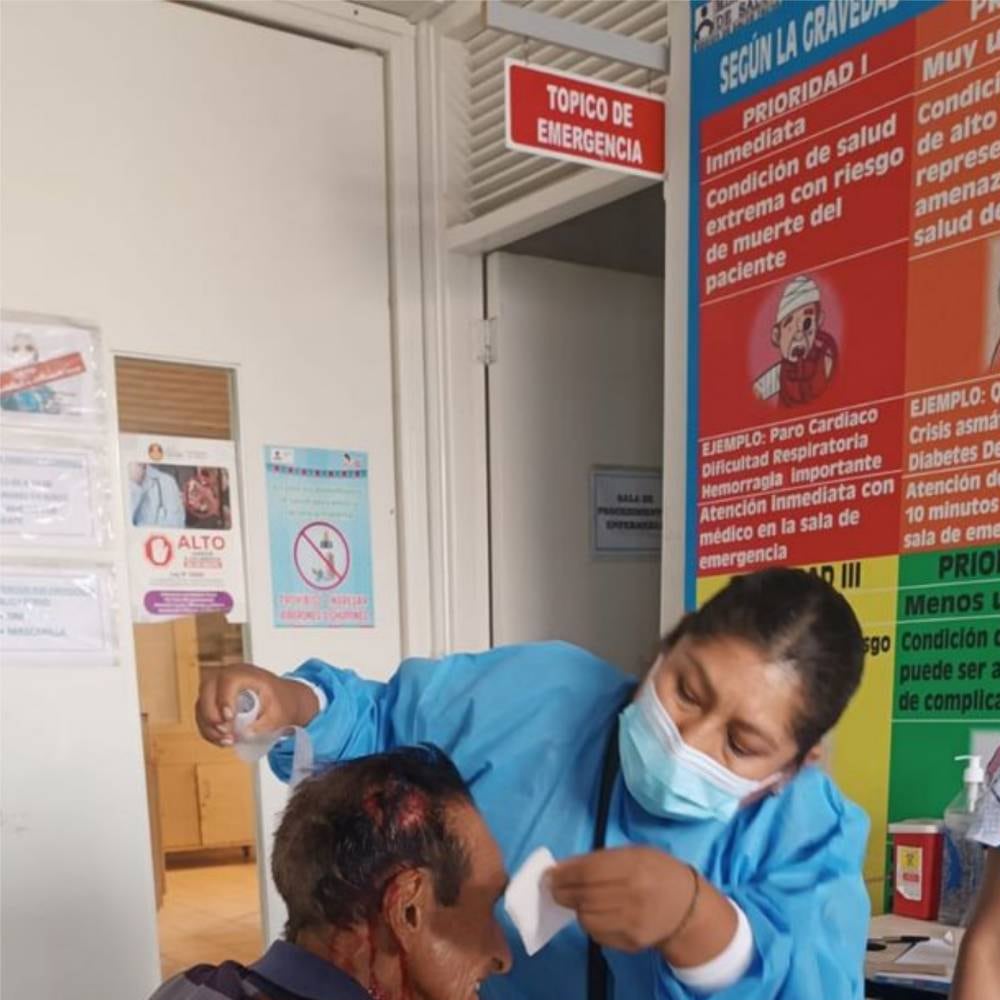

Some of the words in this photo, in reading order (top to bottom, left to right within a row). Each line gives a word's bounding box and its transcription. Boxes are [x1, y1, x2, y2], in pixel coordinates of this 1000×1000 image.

[720, 27, 771, 94] SEGÚN
[777, 20, 798, 62] LA
[802, 0, 899, 56] GRAVED
[922, 40, 977, 82] Muy
[547, 84, 608, 122] TOPICO
[612, 102, 633, 128] DE
[743, 61, 854, 129] PRIORIDAD
[861, 54, 868, 76] I
[537, 118, 643, 164] EMERGENCIA
[706, 117, 805, 174] Inmediata
[916, 133, 943, 156] de
[949, 108, 997, 144] alto
[706, 158, 799, 209] Condición
[806, 145, 830, 169] de
[837, 113, 897, 155] salud
[706, 191, 785, 237] extrema
[791, 179, 827, 205] con
[834, 145, 904, 189] riesgo
[706, 242, 727, 264] de
[733, 214, 804, 254] muerte
[811, 198, 842, 228] del
[914, 209, 972, 248] salud
[706, 249, 786, 295] paciente
[910, 391, 985, 417] EJEMPLO:
[702, 431, 766, 457] EJEMPLO:
[770, 421, 805, 443] Paro
[909, 419, 951, 444] Crisis
[702, 454, 769, 479] Dificultad
[773, 432, 868, 465] Respiratoria
[908, 443, 977, 472] Diabetes
[700, 495, 766, 523] Atención
[862, 478, 894, 498] con
[702, 472, 783, 500] Hemorragia
[906, 473, 980, 500] Atención
[700, 517, 753, 546] médico
[758, 519, 776, 537] en
[782, 514, 796, 533] la
[800, 511, 833, 533] sala
[838, 508, 860, 527] de
[906, 507, 923, 524] 10
[929, 495, 999, 521] minutos
[178, 535, 226, 551] ALTO
[903, 528, 935, 549] sala
[940, 525, 961, 544] de
[700, 543, 787, 569] emergencia
[841, 562, 861, 588] III
[905, 592, 983, 616] Menos
[901, 627, 987, 652] Condición
[901, 660, 953, 683] puede
[957, 662, 986, 680] ser
[900, 691, 920, 711] de
